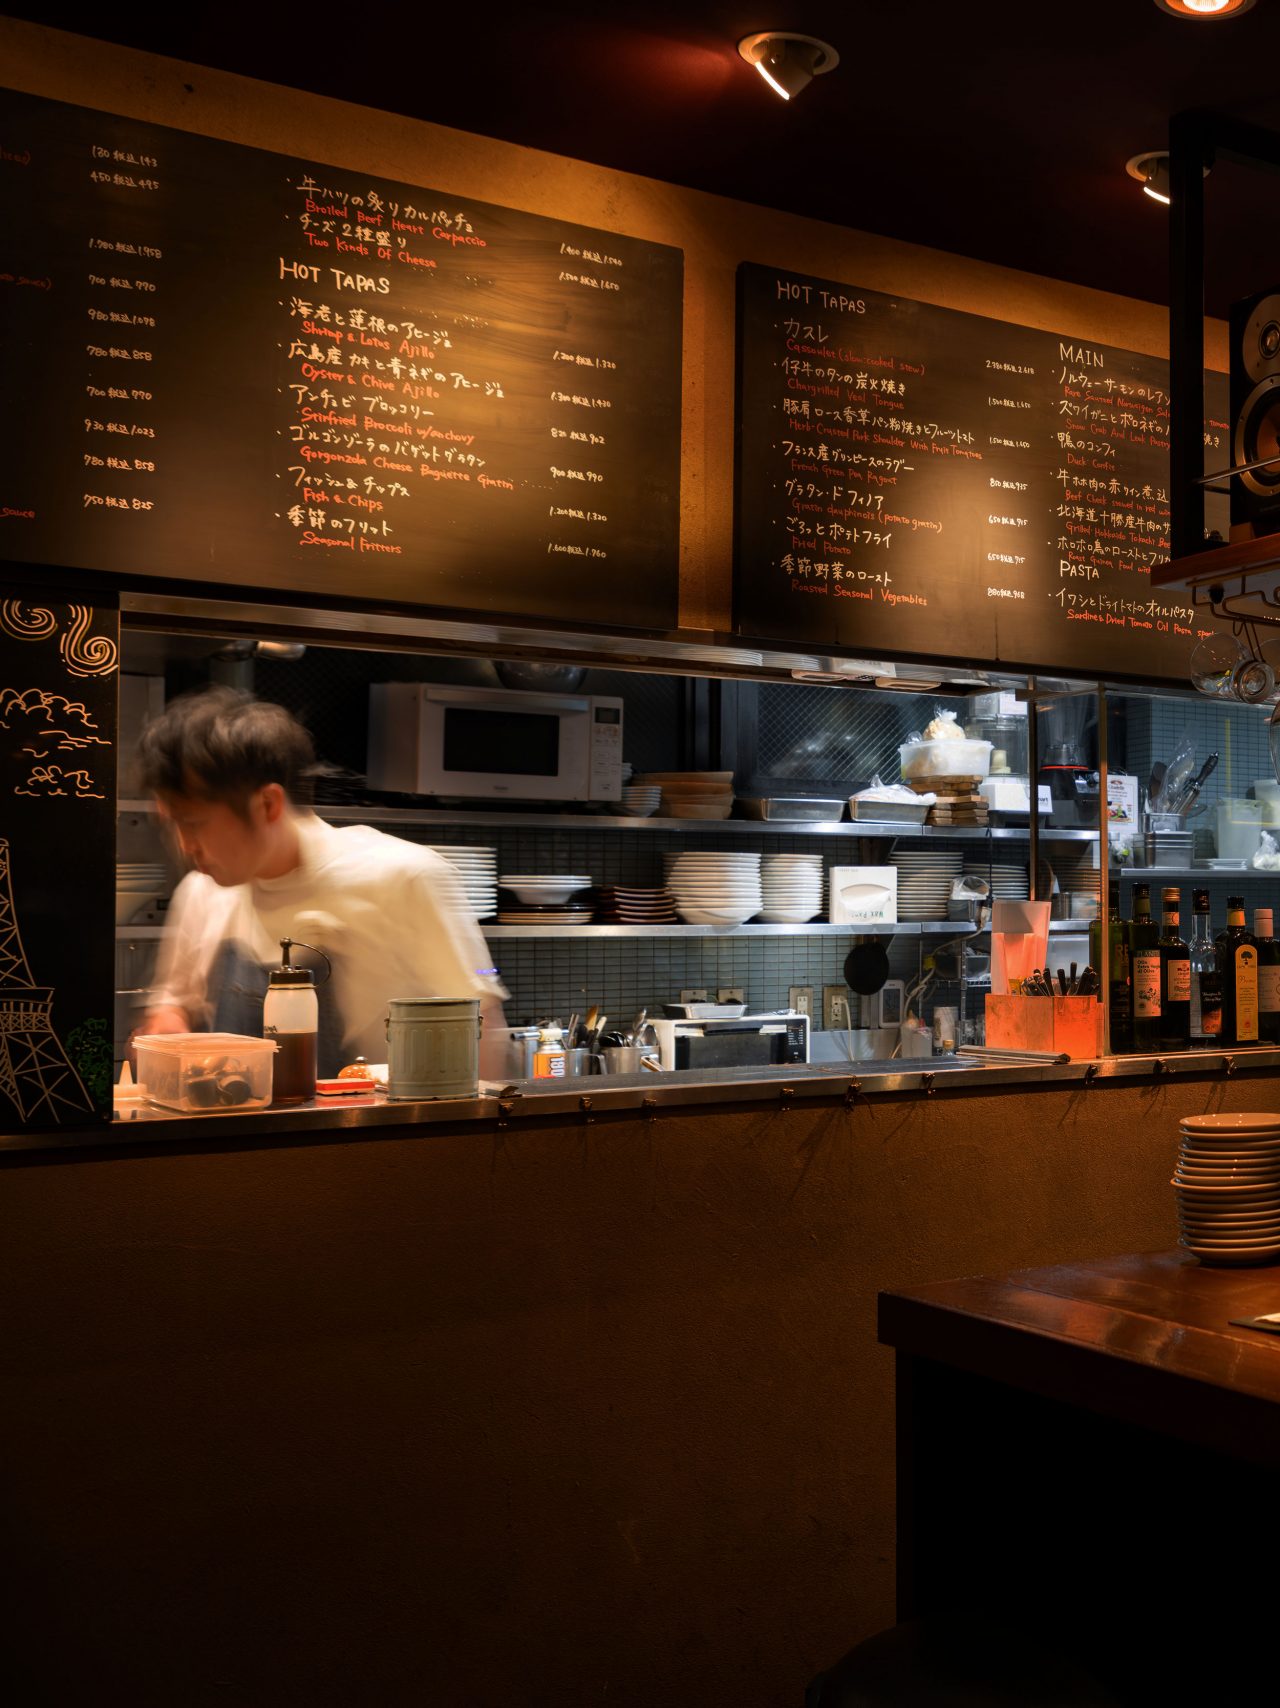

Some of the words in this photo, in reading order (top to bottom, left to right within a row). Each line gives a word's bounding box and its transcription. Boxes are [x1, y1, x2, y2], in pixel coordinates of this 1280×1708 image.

[305, 199, 348, 219] Broiled
[357, 210, 384, 226] Beef
[391, 220, 425, 235] Heart
[432, 227, 487, 248] Carpaccio
[304, 232, 329, 247] Two
[336, 236, 369, 256] Kinds
[398, 251, 438, 269] Cheese
[280, 257, 321, 283] HOT
[330, 268, 390, 294] TAPAS
[777, 280, 813, 305] HOT
[819, 291, 866, 314] TAPAS
[301, 321, 344, 344] Shrimp
[360, 333, 391, 351] Lotus
[399, 340, 436, 360] Ajillo
[783, 317, 830, 343] カスレ
[1059, 342, 1104, 368] MAIN
[301, 363, 345, 382] Oyster
[361, 371, 395, 392] Chive
[402, 382, 440, 399] Ajillo
[782, 356, 906, 397] 仔牛のタンの炭火焼き
[301, 407, 357, 427] Stirfried
[363, 416, 412, 436] Broccoli
[416, 426, 475, 446] w/anchovy
[300, 446, 367, 466] Gorgonzola
[373, 456, 414, 473] Cheese
[420, 463, 471, 482] Baguette
[303, 487, 330, 503] Fish
[348, 494, 384, 513] Chips
[287, 505, 393, 537] 季節のフリット
[300, 531, 354, 551] Seasonal
[360, 539, 403, 555] Fritters
[780, 553, 892, 587] 季節野菜のロースト
[1060, 559, 1100, 581] PASTA
[791, 578, 828, 596] Roasted
[833, 585, 873, 601] Seasonal
[881, 588, 927, 606] Vegetables
